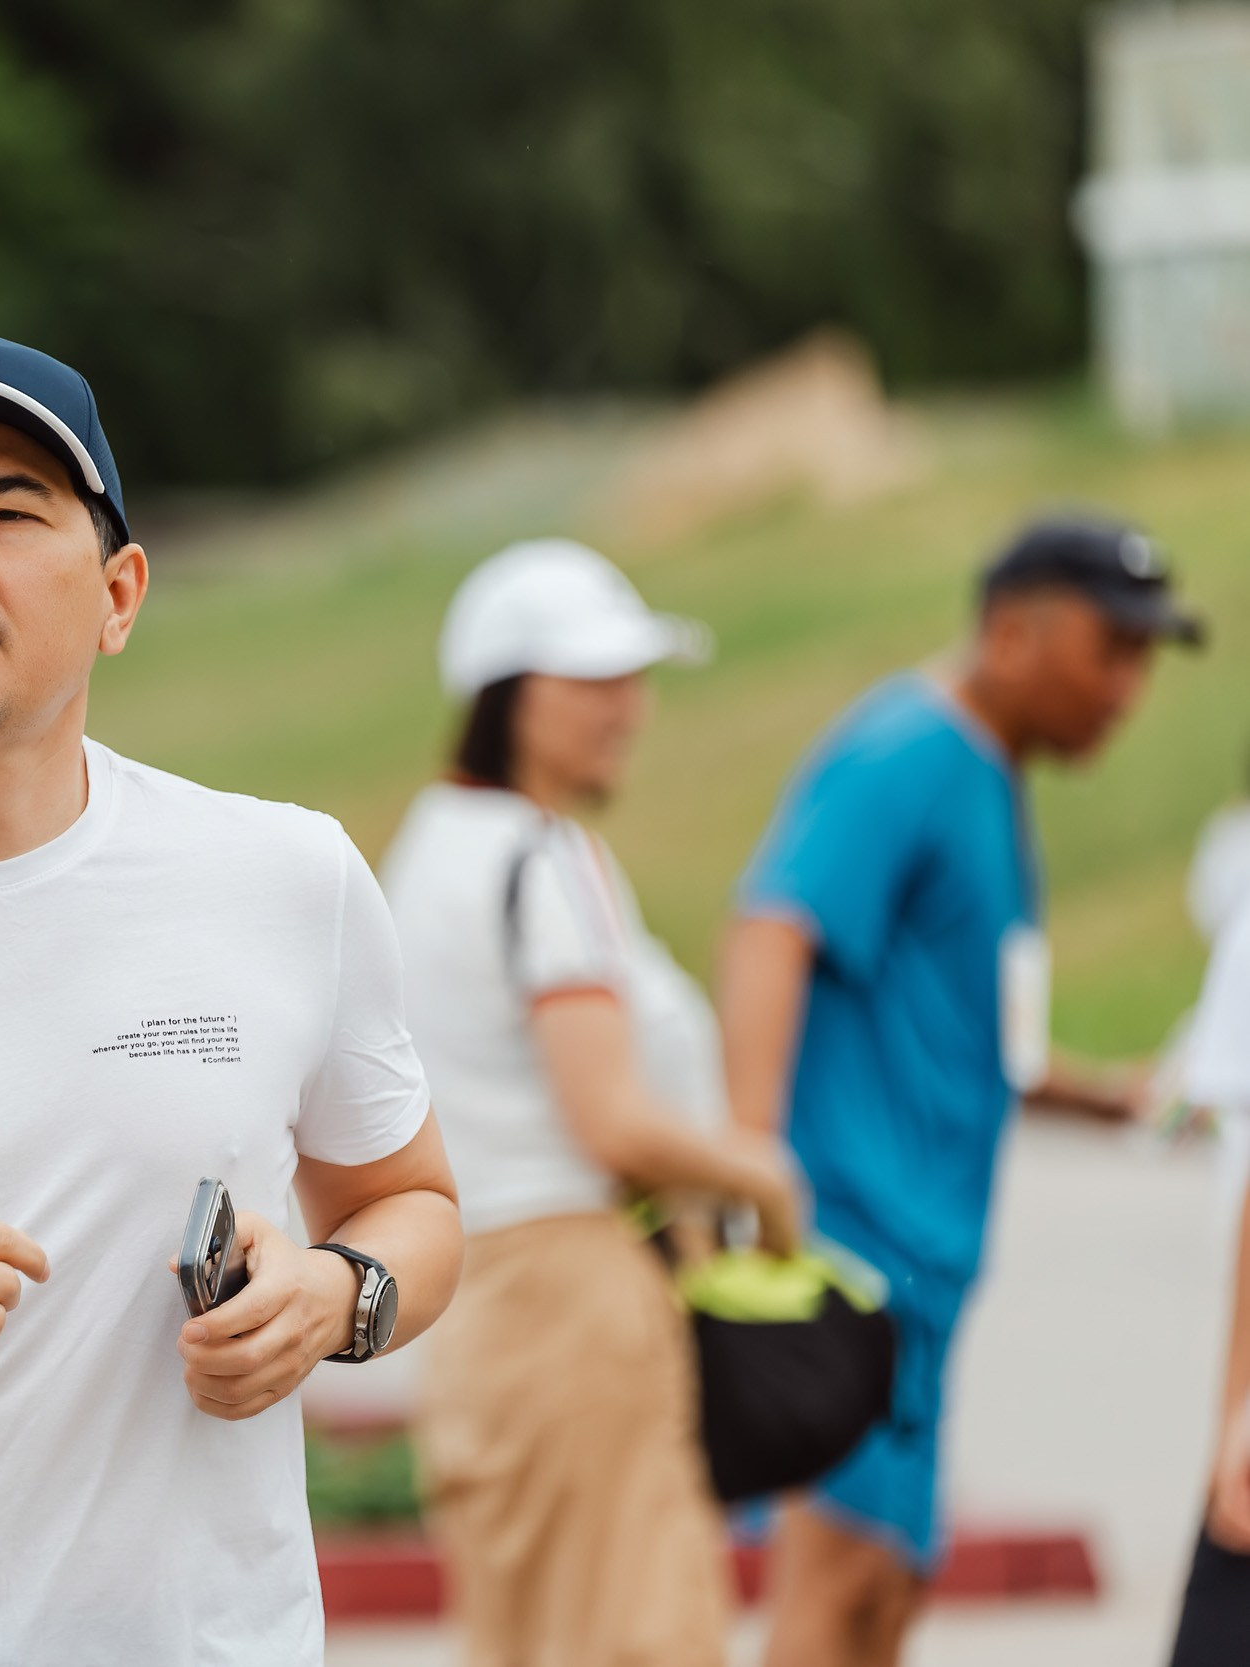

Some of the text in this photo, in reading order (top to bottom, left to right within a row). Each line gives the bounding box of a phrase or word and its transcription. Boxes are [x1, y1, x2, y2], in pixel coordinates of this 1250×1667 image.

[147, 1020, 166, 1028] plan
[117, 1032, 141, 1041] create
[143, 1031, 160, 1039] your
[92, 1044, 128, 1054] wherever
[129, 1050, 161, 1058] because
